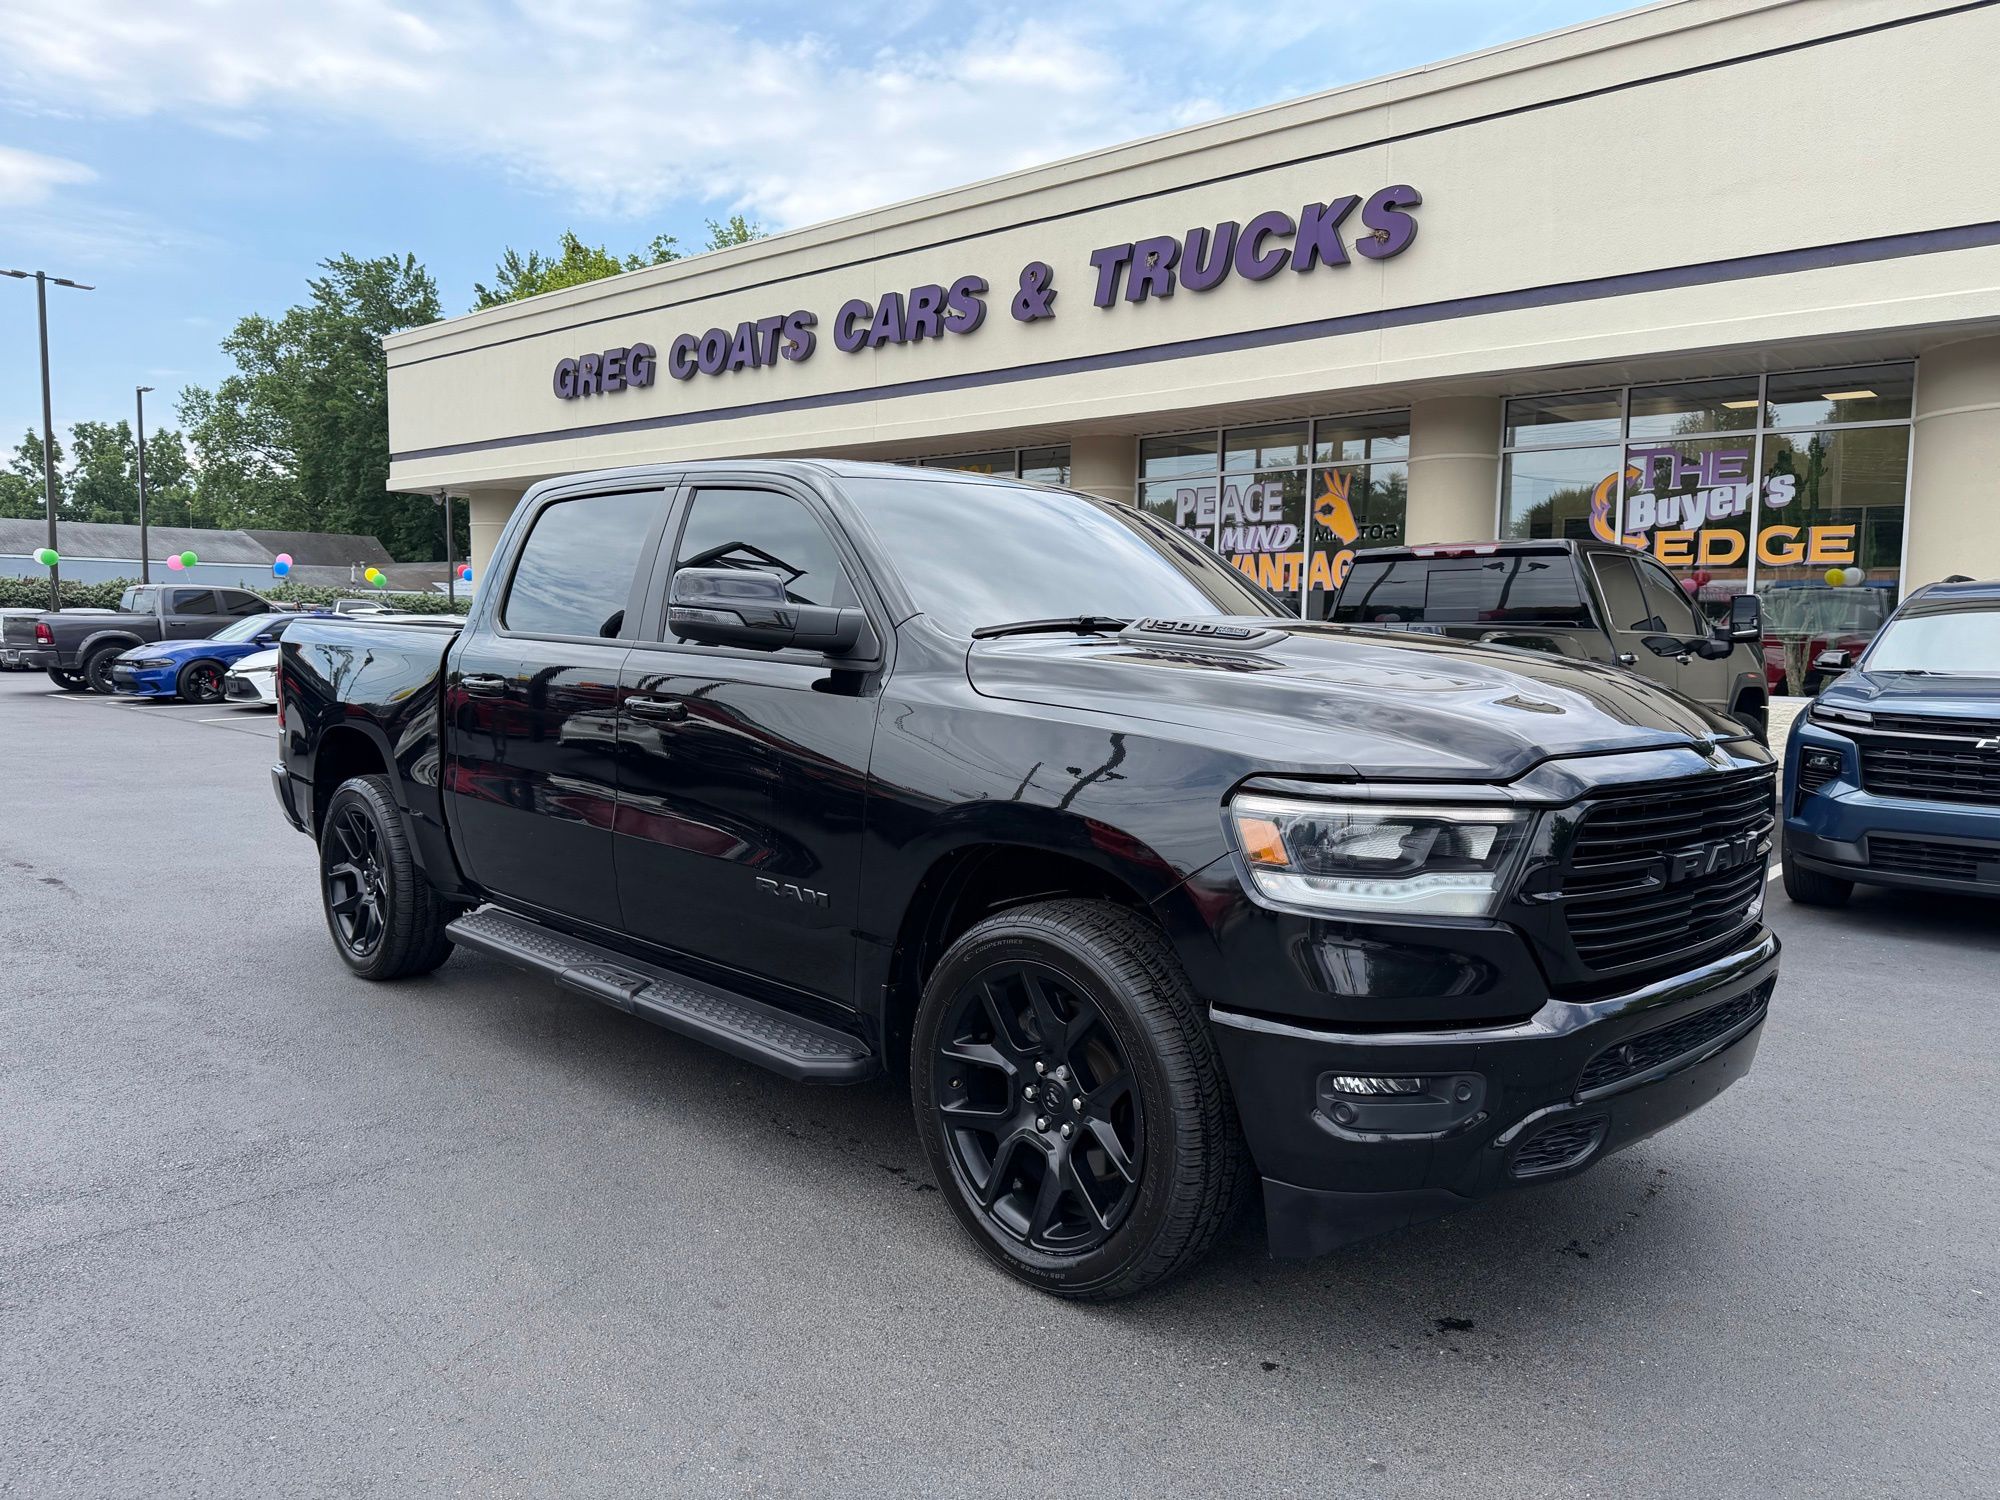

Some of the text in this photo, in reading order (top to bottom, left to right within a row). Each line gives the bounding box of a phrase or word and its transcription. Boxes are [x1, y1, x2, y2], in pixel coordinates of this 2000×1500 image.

[553, 184, 1422, 399] GREG COATS CARS & TRUCKS
[1627, 448, 1748, 491] THE
[1175, 482, 1283, 526] PEACE
[1627, 474, 1796, 532] Buyer's
[1220, 523, 1298, 552] MIND
[1654, 524, 1856, 566] EDGE
[1230, 549, 1355, 592] ANTAG
[1145, 617, 1219, 635] 1500
[1670, 836, 1757, 883] RAM
[756, 876, 830, 909] RAM
